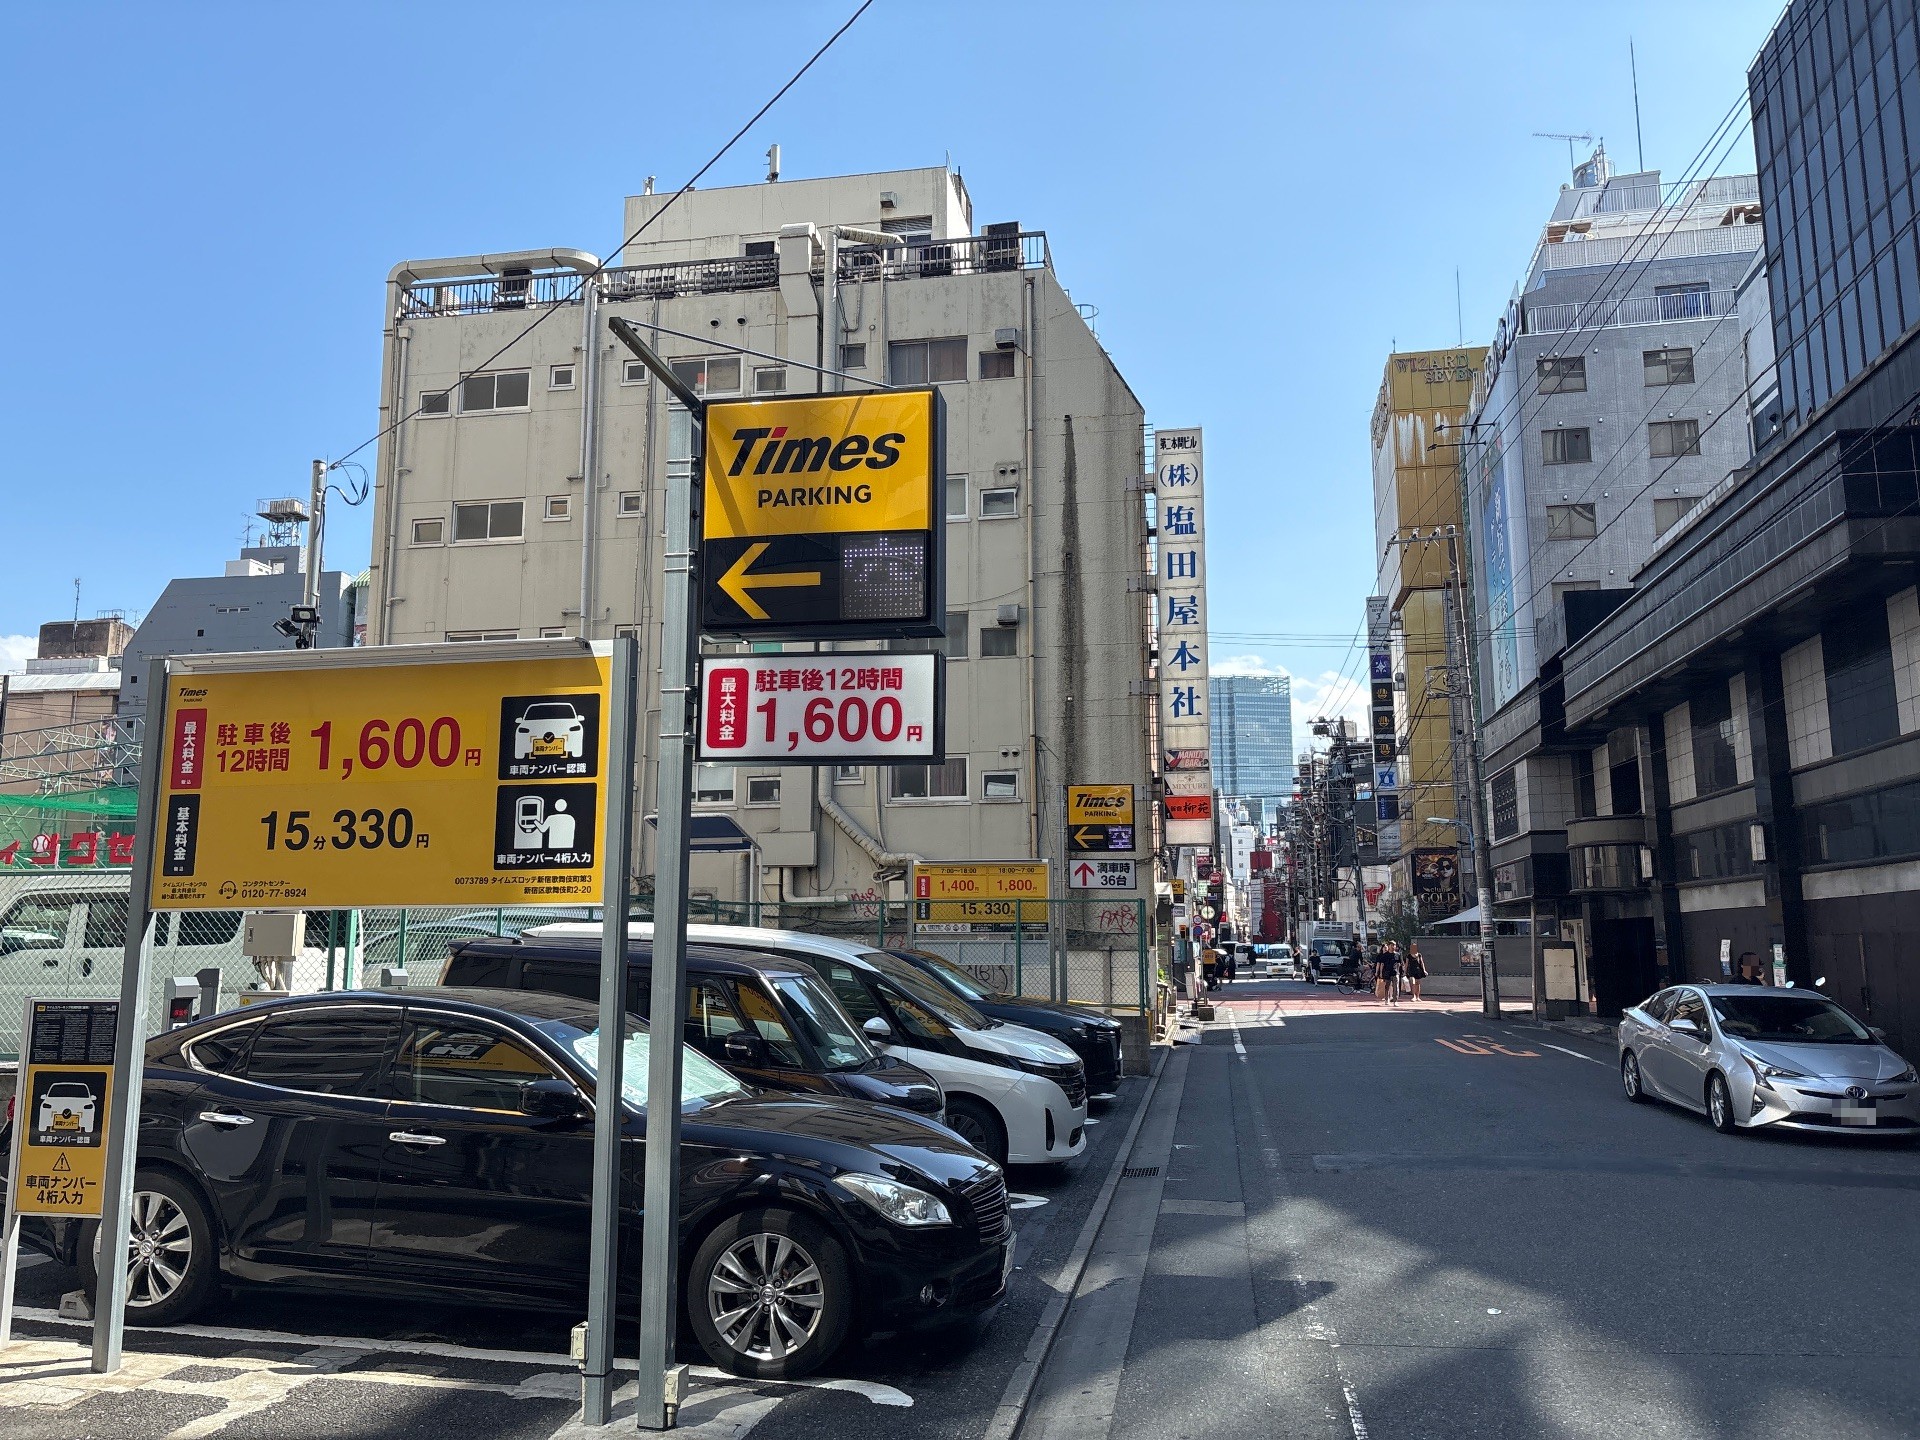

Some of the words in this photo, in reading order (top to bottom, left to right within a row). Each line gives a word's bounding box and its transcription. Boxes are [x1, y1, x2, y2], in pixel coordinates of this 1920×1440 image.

[1394, 354, 1468, 372] WIZARD
[728, 427, 906, 477] Times
[758, 484, 872, 508] PARKING
[755, 668, 903, 691] 駐車後12時間
[179, 688, 208, 697] Times
[719, 677, 736, 741] 最大料金
[217, 722, 291, 746] 駐車後
[180, 721, 197, 774] 最大料金
[217, 748, 290, 772] 12時間
[1184, 759, 1199, 768] BAR
[509, 763, 587, 775] 車両ナンバー認識
[1075, 794, 1126, 808] Times
[174, 807, 190, 860] 基本料金
[1109, 826, 1132, 848] 空
[496, 852, 591, 864] 車両ナンバー4桁入力
[1097, 862, 1130, 874] 満車時
[1101, 875, 1127, 886] 36台
[241, 888, 307, 898] 0120-77-8924
[1422, 893, 1457, 903] GOLD
[26, 1175, 97, 1190] 車両ナンバー
[36, 1190, 84, 1206] 4桁入力
